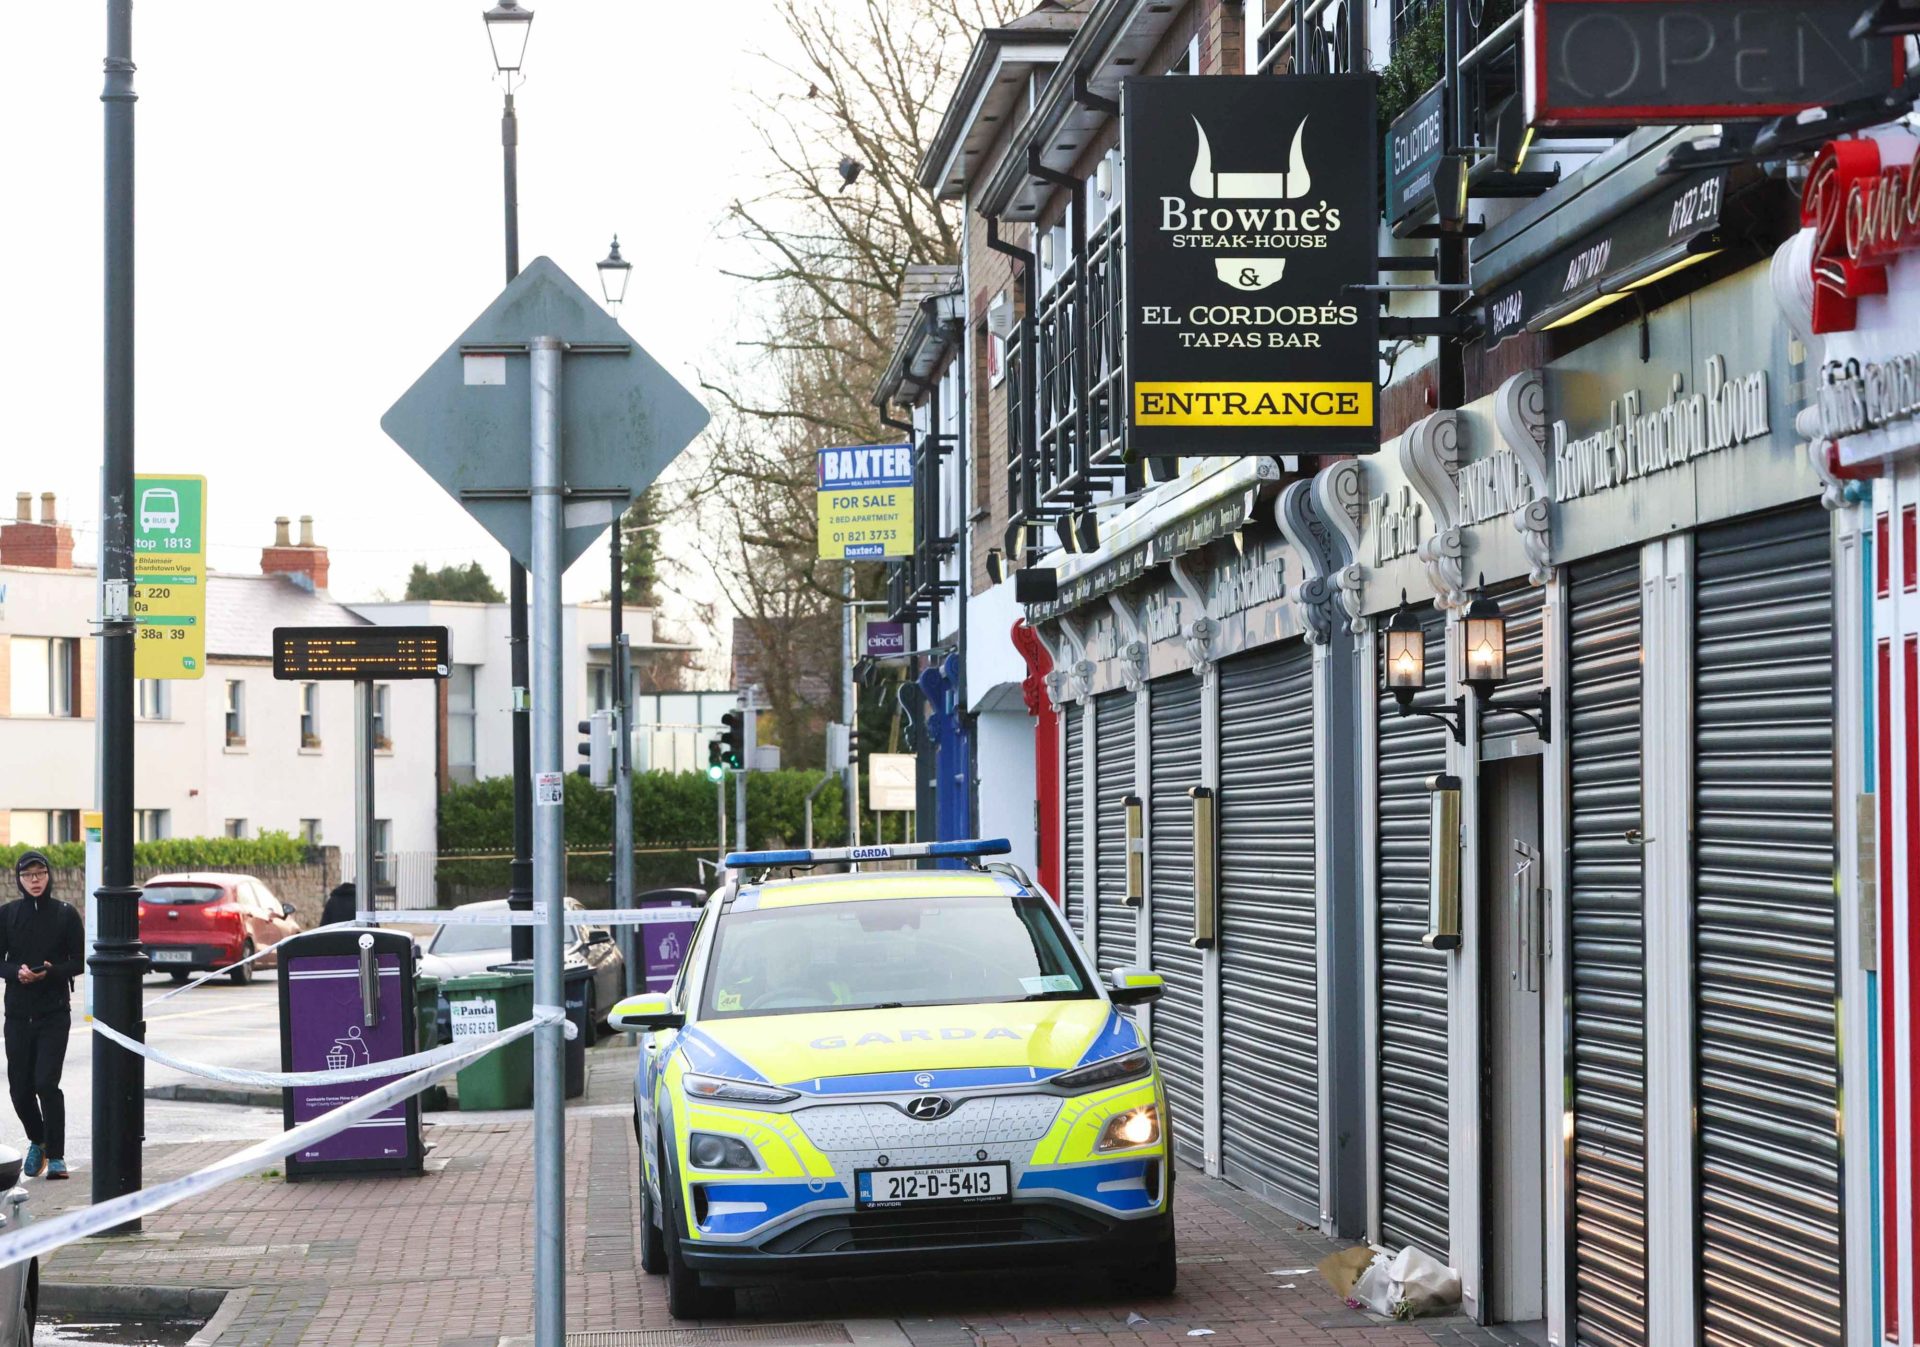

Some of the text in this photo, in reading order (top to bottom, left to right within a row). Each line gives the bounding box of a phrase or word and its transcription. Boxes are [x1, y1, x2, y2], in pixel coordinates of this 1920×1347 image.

[1556, 10, 1870, 98] OPEN
[1160, 196, 1342, 232] Browne’s
[1172, 233, 1328, 249] STEAK-HOUSE
[1238, 267, 1262, 287] &
[1141, 300, 1359, 326] EL CORDOBÉS
[1178, 331, 1322, 349] TAPAS BAR
[1140, 392, 1360, 416] ENTRANCE
[1624, 372, 1706, 480] Function
[1704, 354, 1770, 452] Room
[824, 448, 912, 480] BAXTER
[833, 494, 896, 510] FOR SALE
[836, 515, 851, 524] BED
[852, 513, 899, 523] APARTMENT
[1369, 486, 1422, 567] Wine Bar
[134, 537, 193, 551] top 1813
[833, 529, 897, 543] 01 821 3733
[845, 545, 883, 556] baxter.ie
[148, 588, 170, 599] 220
[141, 628, 185, 639] 38a 39
[852, 848, 889, 858] GARDA
[460, 1006, 495, 1016] Panda
[469, 1023, 476, 1034] 62
[479, 1022, 486, 1034] 62
[488, 1021, 496, 1033] 62
[809, 1027, 1024, 1050] GARDA
[888, 1172, 991, 1199] 212-D-5413
